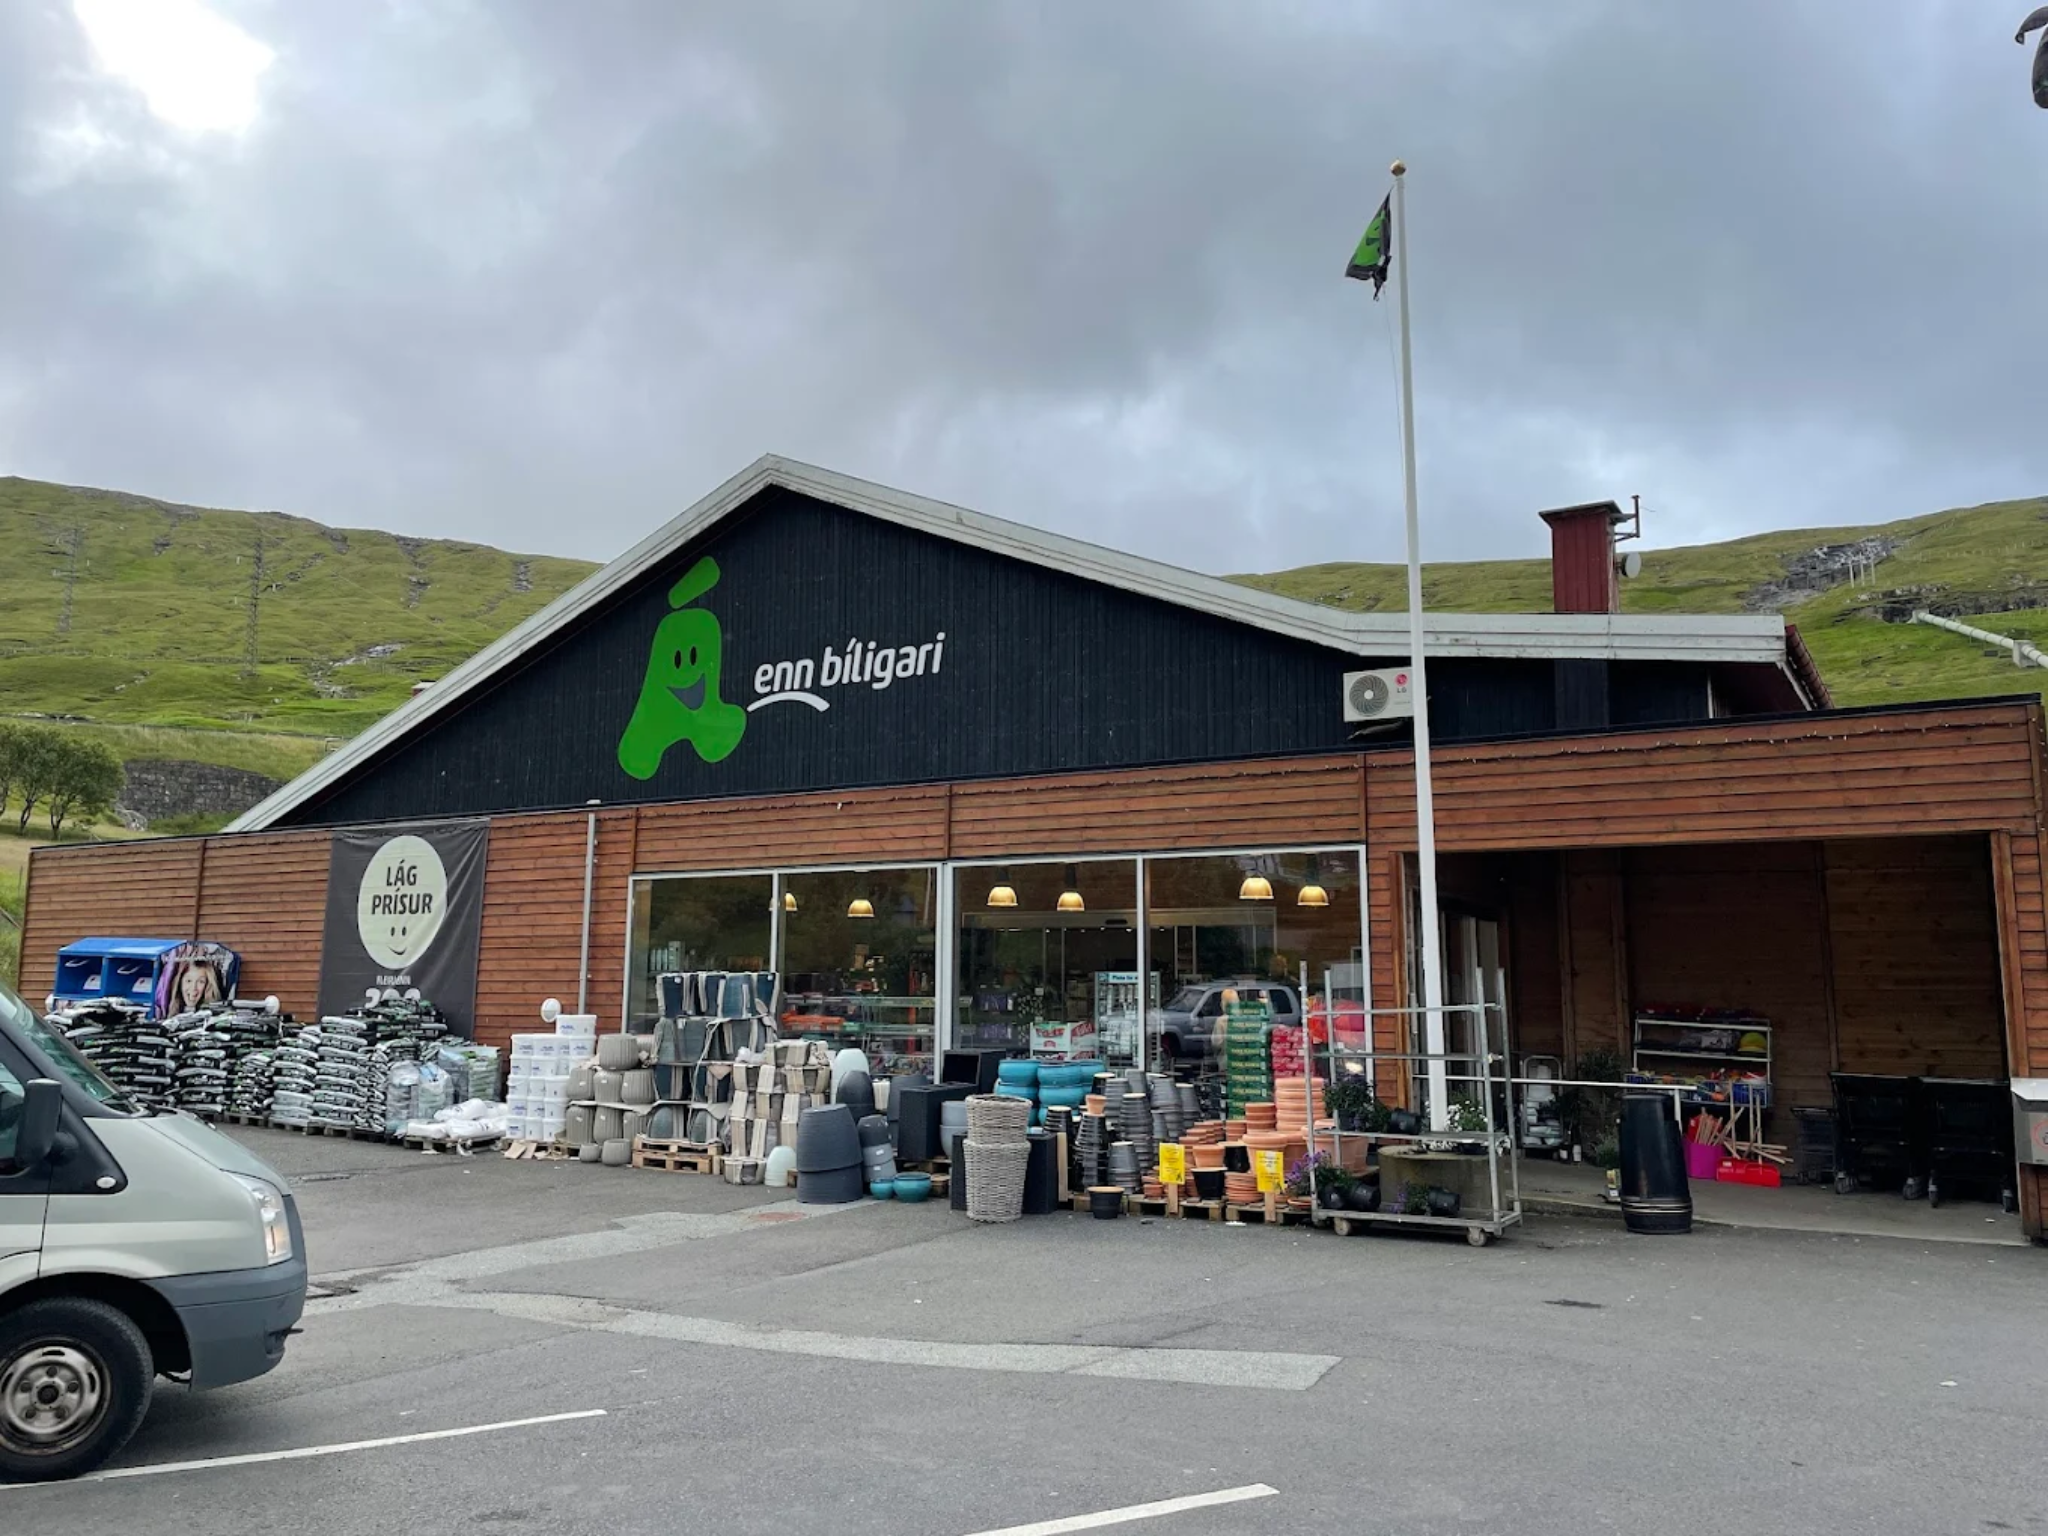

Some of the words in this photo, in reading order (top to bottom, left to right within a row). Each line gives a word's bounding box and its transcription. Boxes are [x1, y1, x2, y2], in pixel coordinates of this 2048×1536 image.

[753, 657, 814, 694] enn
[820, 632, 946, 690] bíligari
[386, 859, 418, 887] LÁG
[371, 888, 433, 915] PRÍSUR
